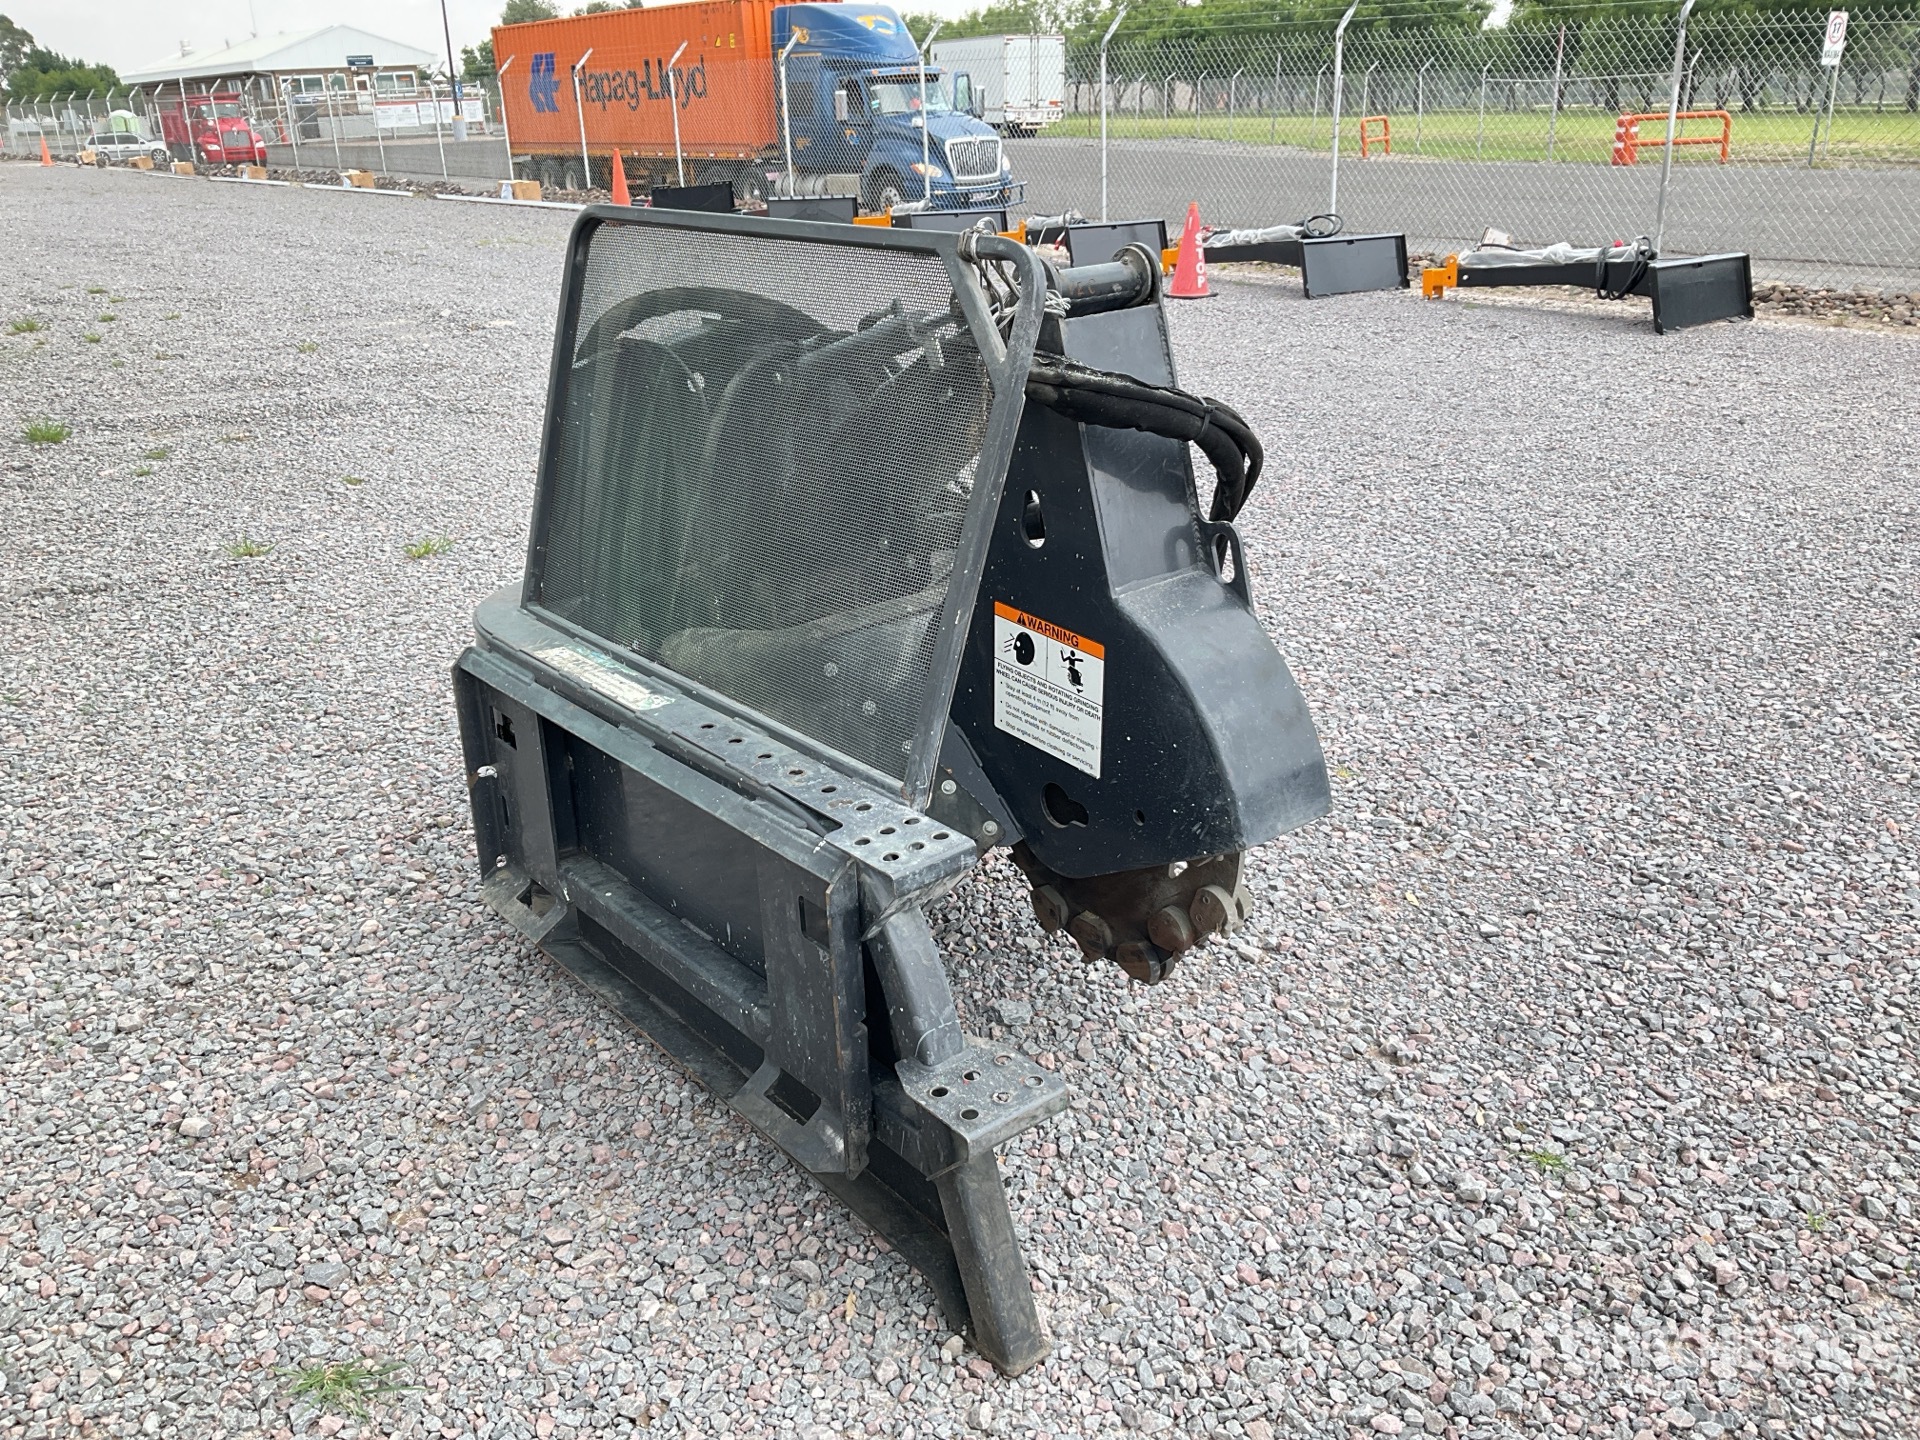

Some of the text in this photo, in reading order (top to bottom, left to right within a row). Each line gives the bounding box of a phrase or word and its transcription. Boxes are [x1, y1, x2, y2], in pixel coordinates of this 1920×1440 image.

[571, 54, 707, 111] Hapag-Lloyd
[1194, 232, 1205, 289] STOP
[1026, 615, 1078, 647] WARNING
[996, 668, 1100, 721] WHEEL CAN CAUSE SERIOUS INJURY OR DEATH
[997, 661, 1098, 712] FLYING OBJECTS AND ROTATING GRINDING
